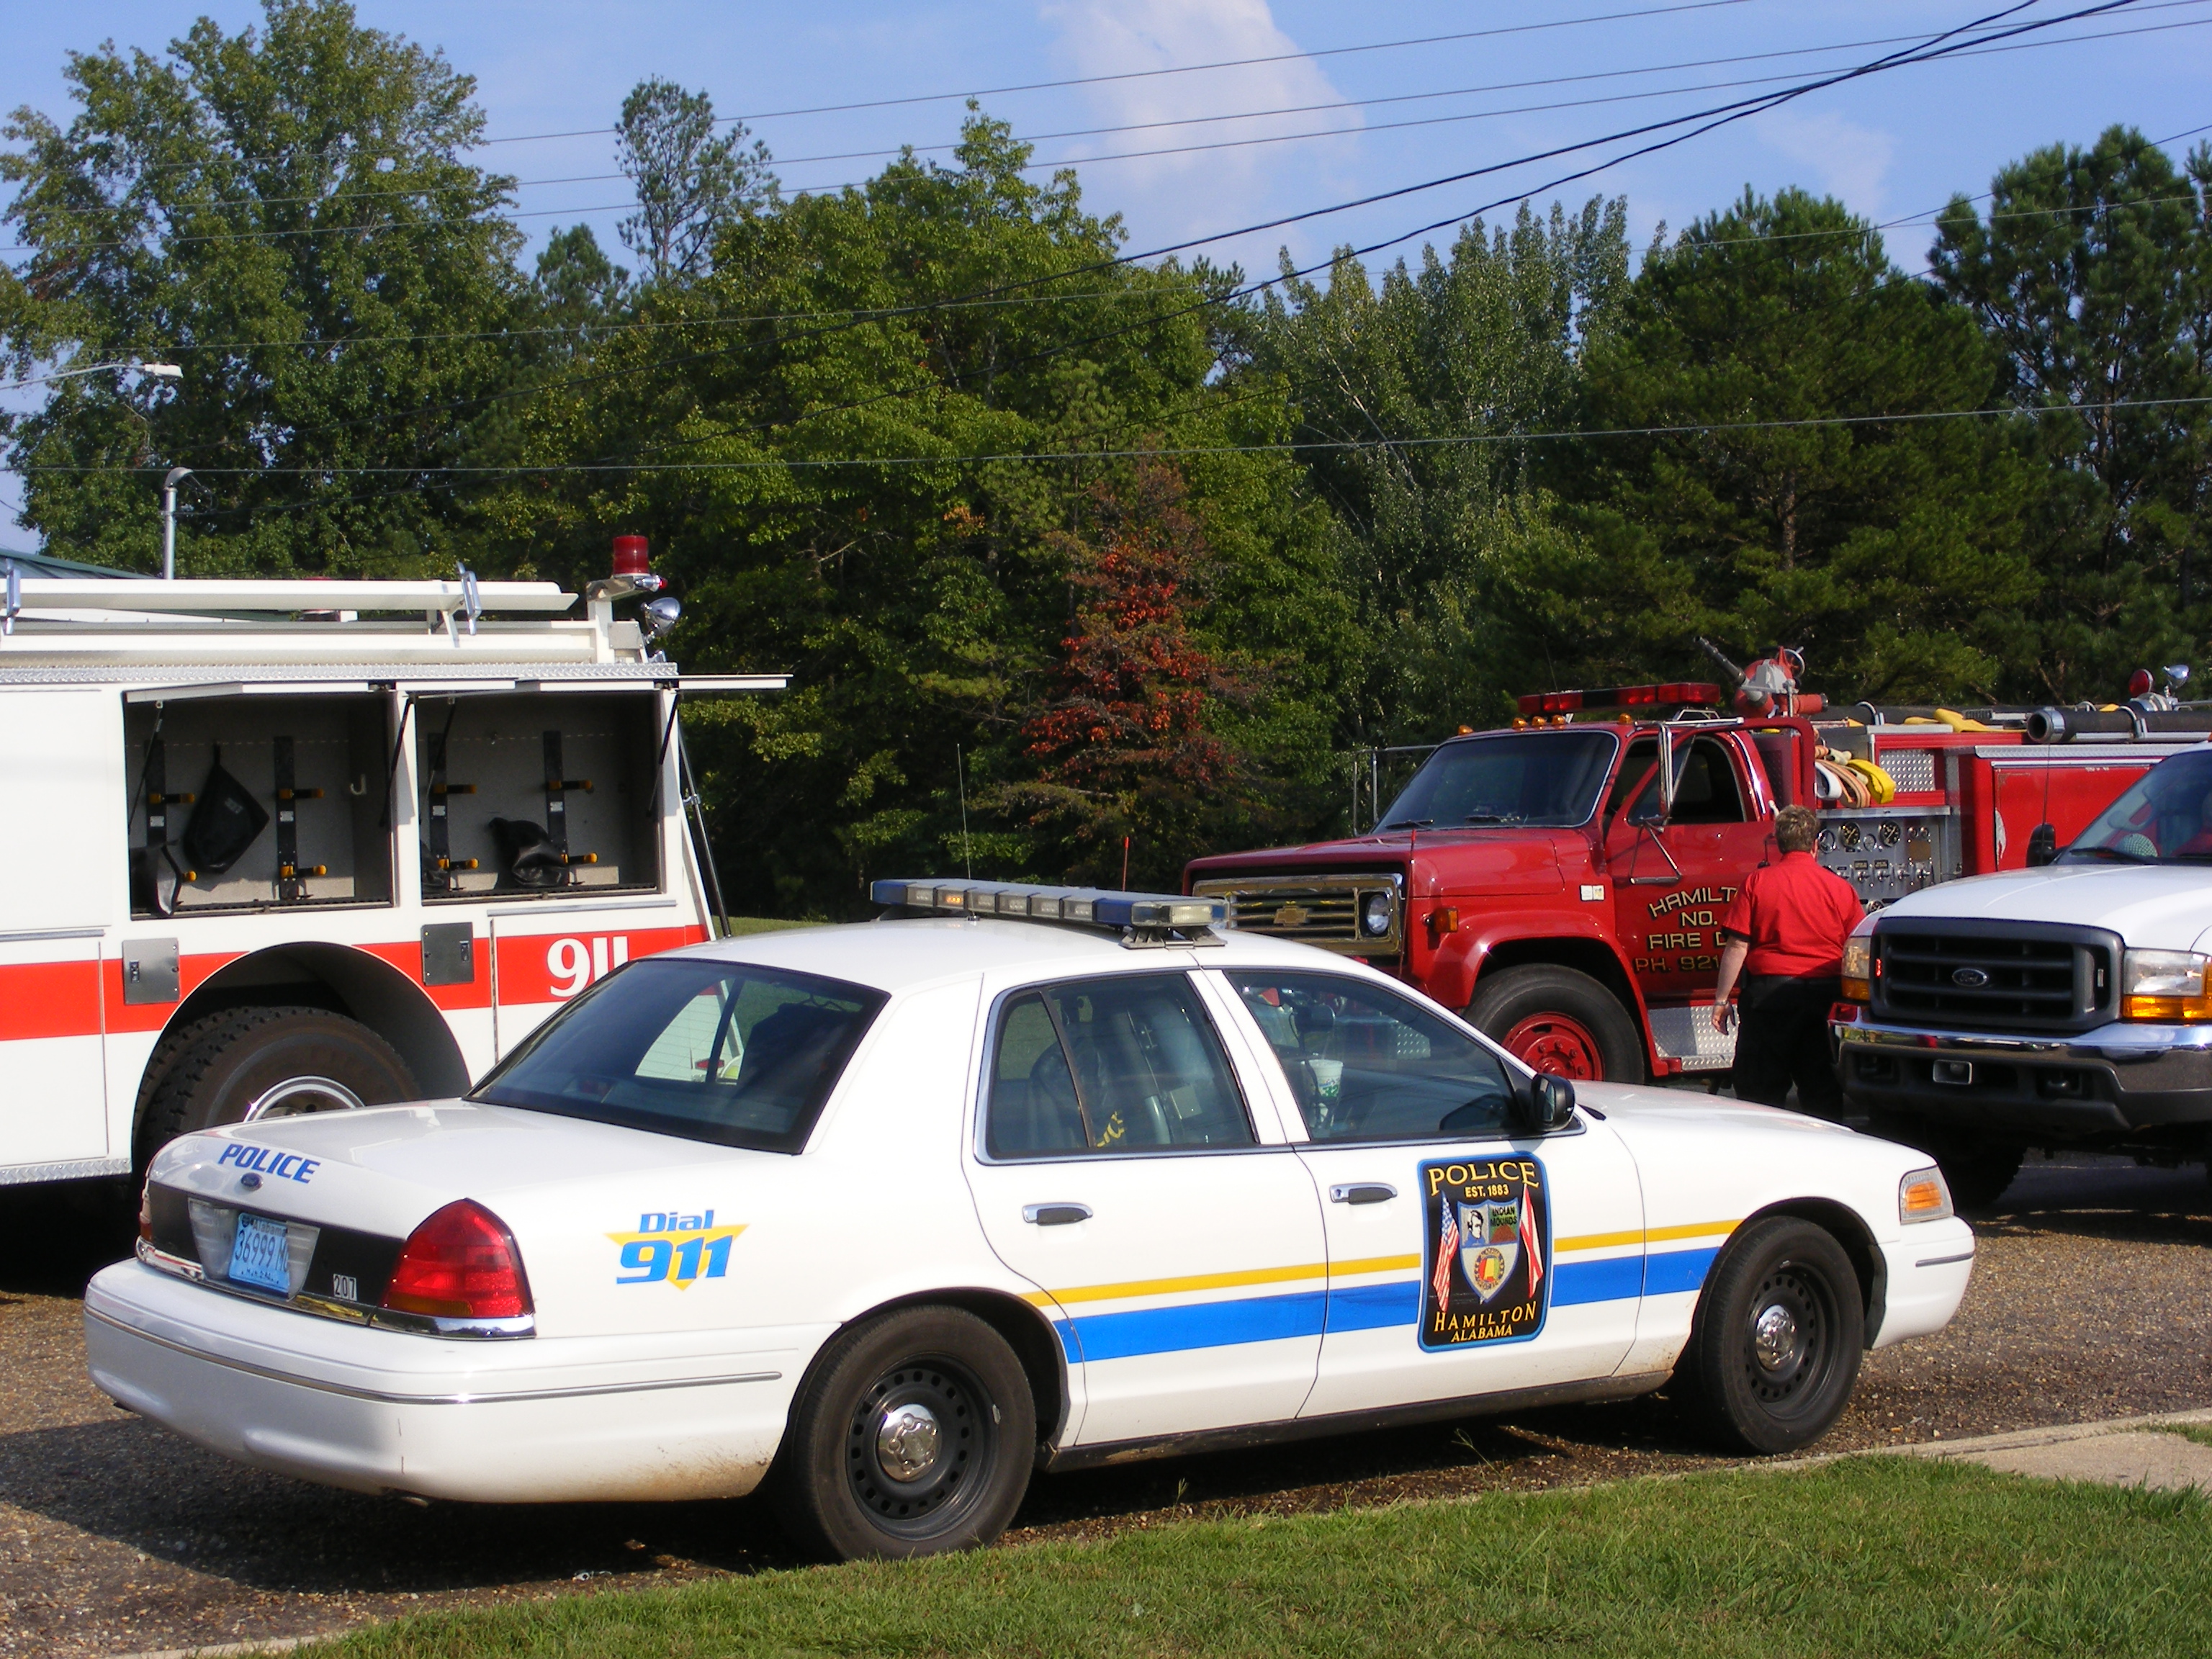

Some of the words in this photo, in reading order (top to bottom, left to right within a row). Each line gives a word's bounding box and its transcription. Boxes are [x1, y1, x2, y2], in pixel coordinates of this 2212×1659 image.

[1649, 886, 1737, 917] HAMILT
[1681, 910, 1718, 927] NO.
[1649, 932, 1701, 950] FIRE
[547, 936, 629, 998] 911
[1681, 955, 1719, 971] 921
[218, 1143, 320, 1184] POLICE
[1428, 1161, 1539, 1196] POLICE
[1465, 1186, 1486, 1198] EST.
[1488, 1184, 1509, 1197] 1883
[639, 1210, 714, 1233] Dial
[235, 1229, 275, 1268] 36999
[616, 1235, 733, 1285] 911
[334, 1275, 354, 1298] 207
[1434, 1300, 1537, 1332] HAMILTON
[1450, 1323, 1513, 1343] ALABAMA
